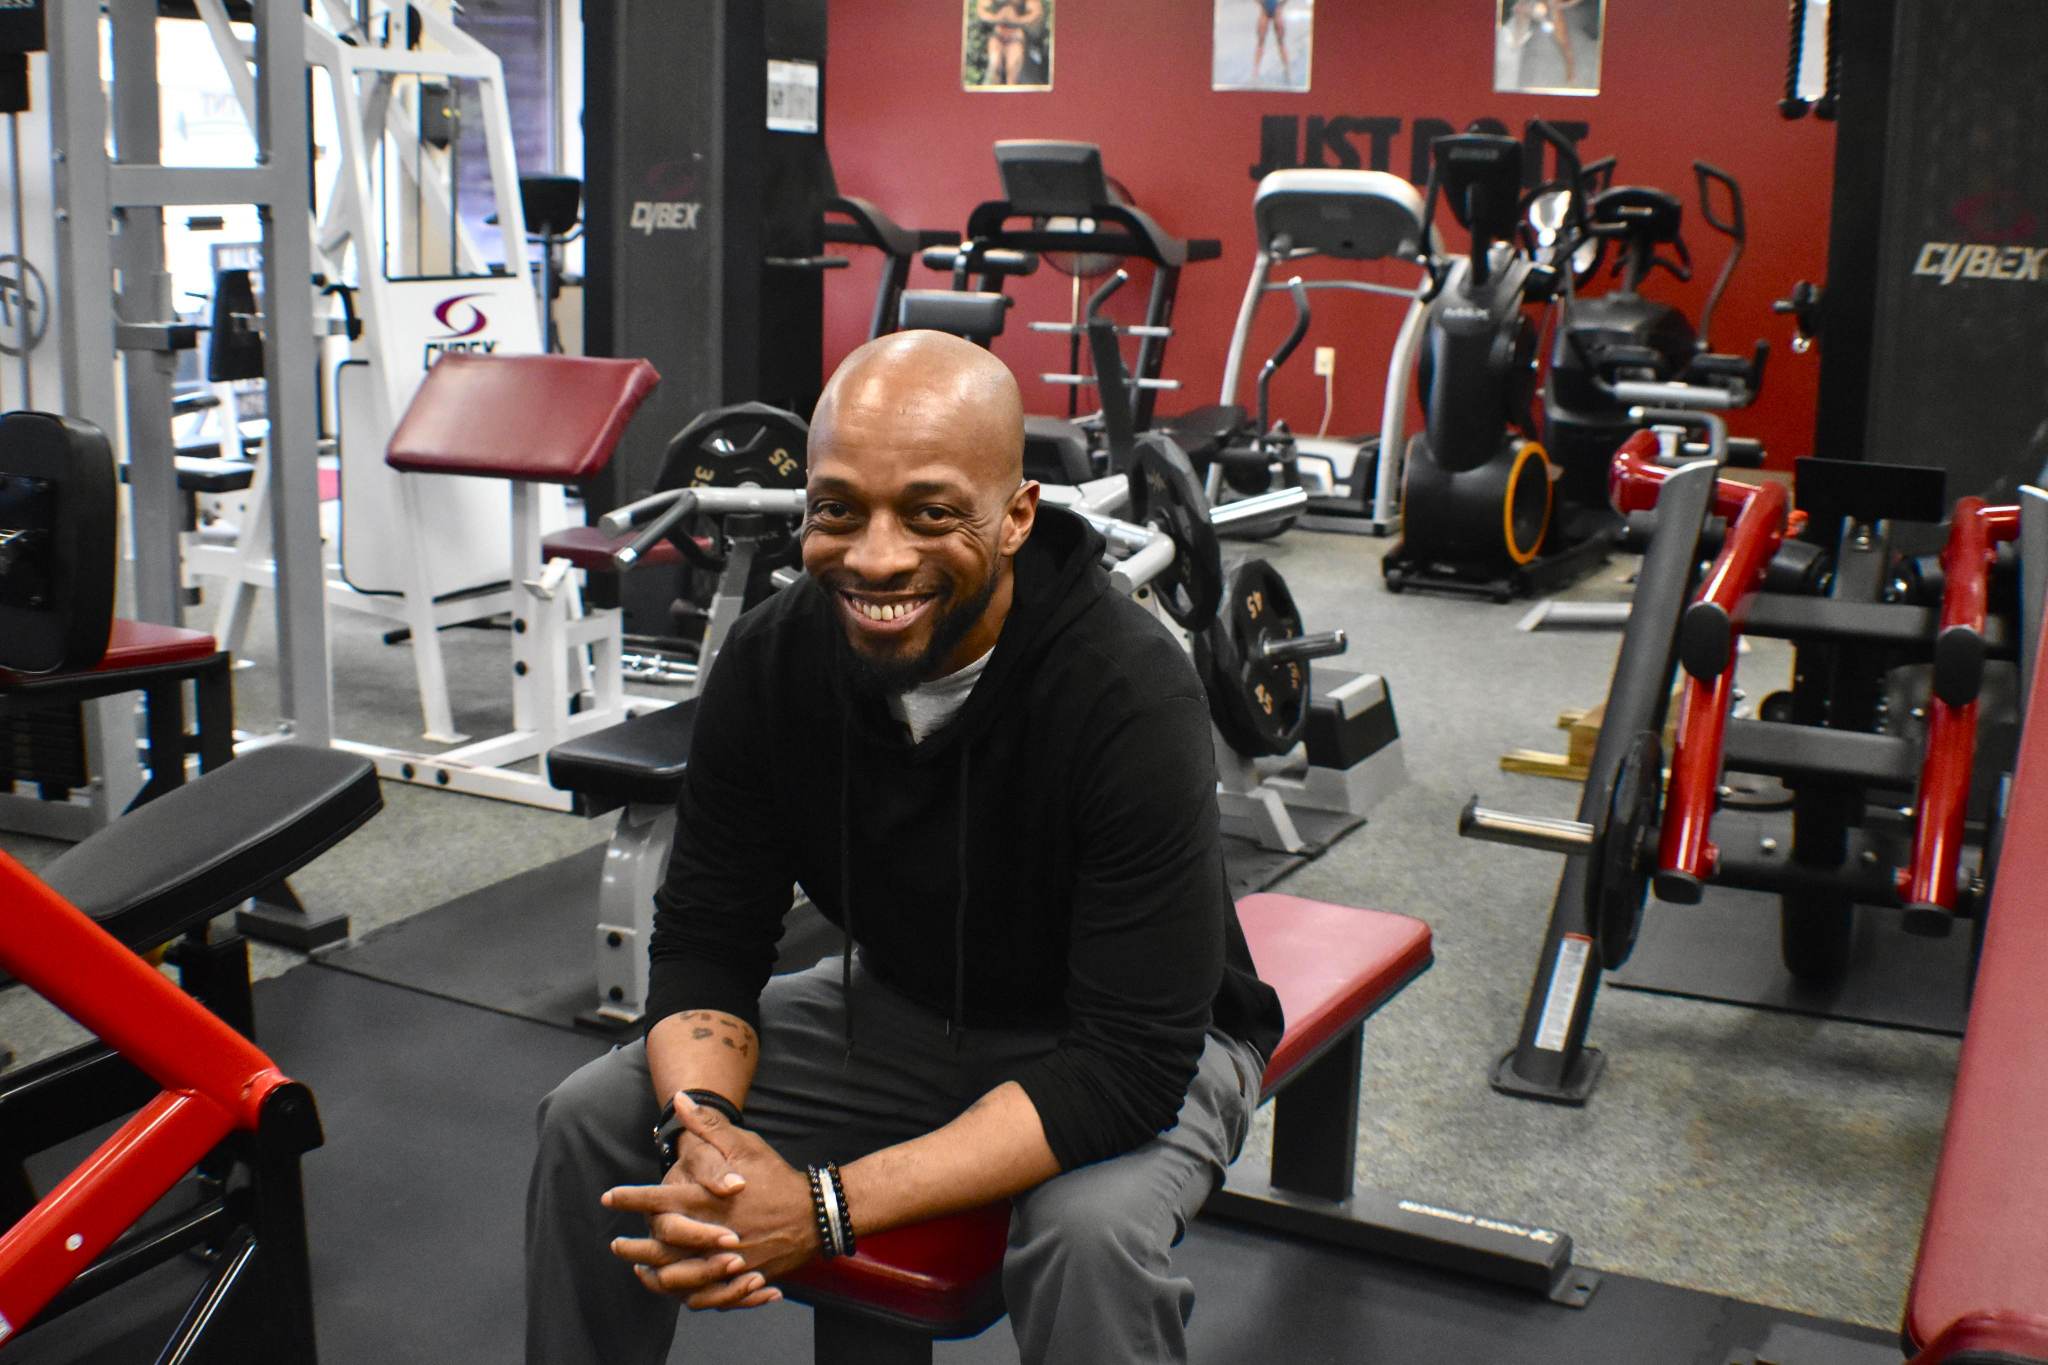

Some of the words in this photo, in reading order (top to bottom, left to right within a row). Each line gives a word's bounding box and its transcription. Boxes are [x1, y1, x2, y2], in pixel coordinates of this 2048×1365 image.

[630, 201, 703, 235] CYBEX
[1912, 242, 2048, 285] CYBEX
[1246, 590, 1264, 620] 45
[1254, 682, 1274, 716] 45
